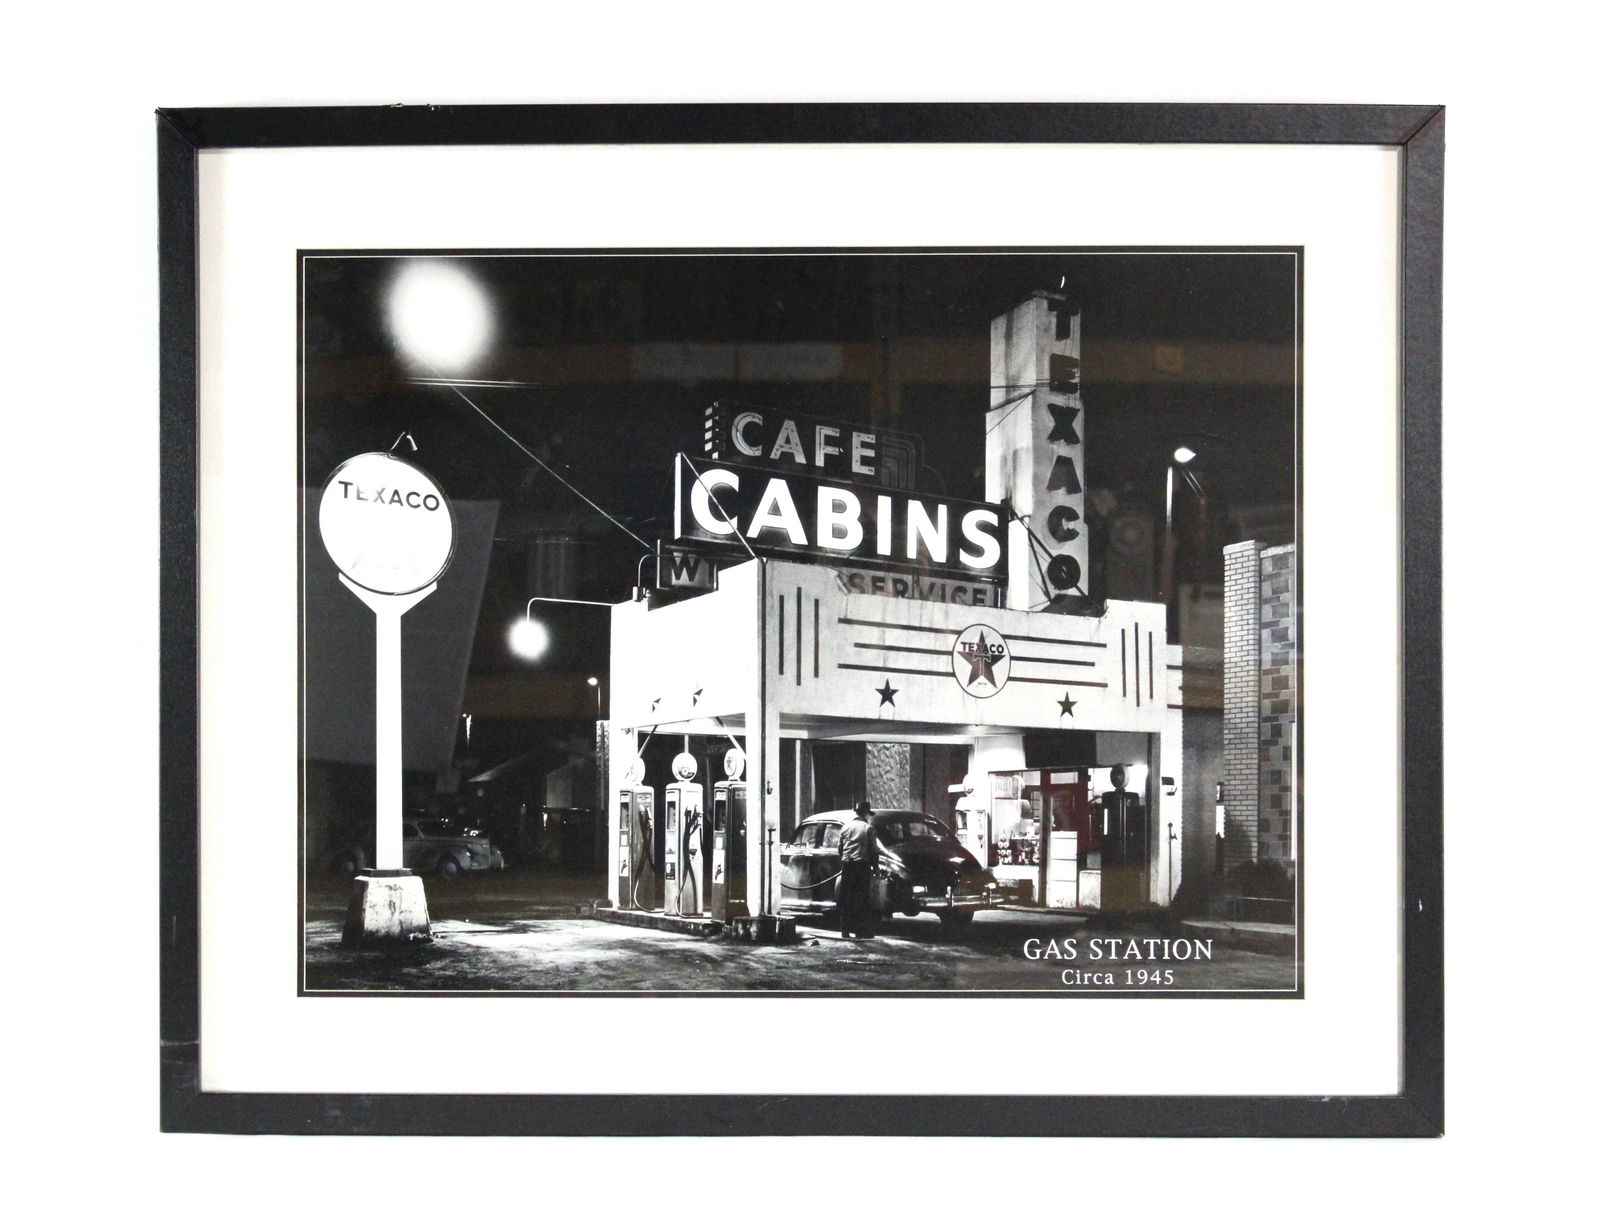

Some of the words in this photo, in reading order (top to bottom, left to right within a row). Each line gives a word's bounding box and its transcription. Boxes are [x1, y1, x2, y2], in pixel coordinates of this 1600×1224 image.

[731, 411, 876, 475] CAFE
[1047, 299, 1082, 591] TEXACO
[338, 480, 440, 511] TEXACO
[690, 468, 1001, 569] CABINS
[849, 572, 988, 607] SERVICE
[960, 641, 1005, 655] TEXACO
[1023, 938, 1078, 960] GAS
[1089, 938, 1214, 960] STATION
[1061, 969, 1115, 985] Circa
[1125, 969, 1175, 985] 1945
